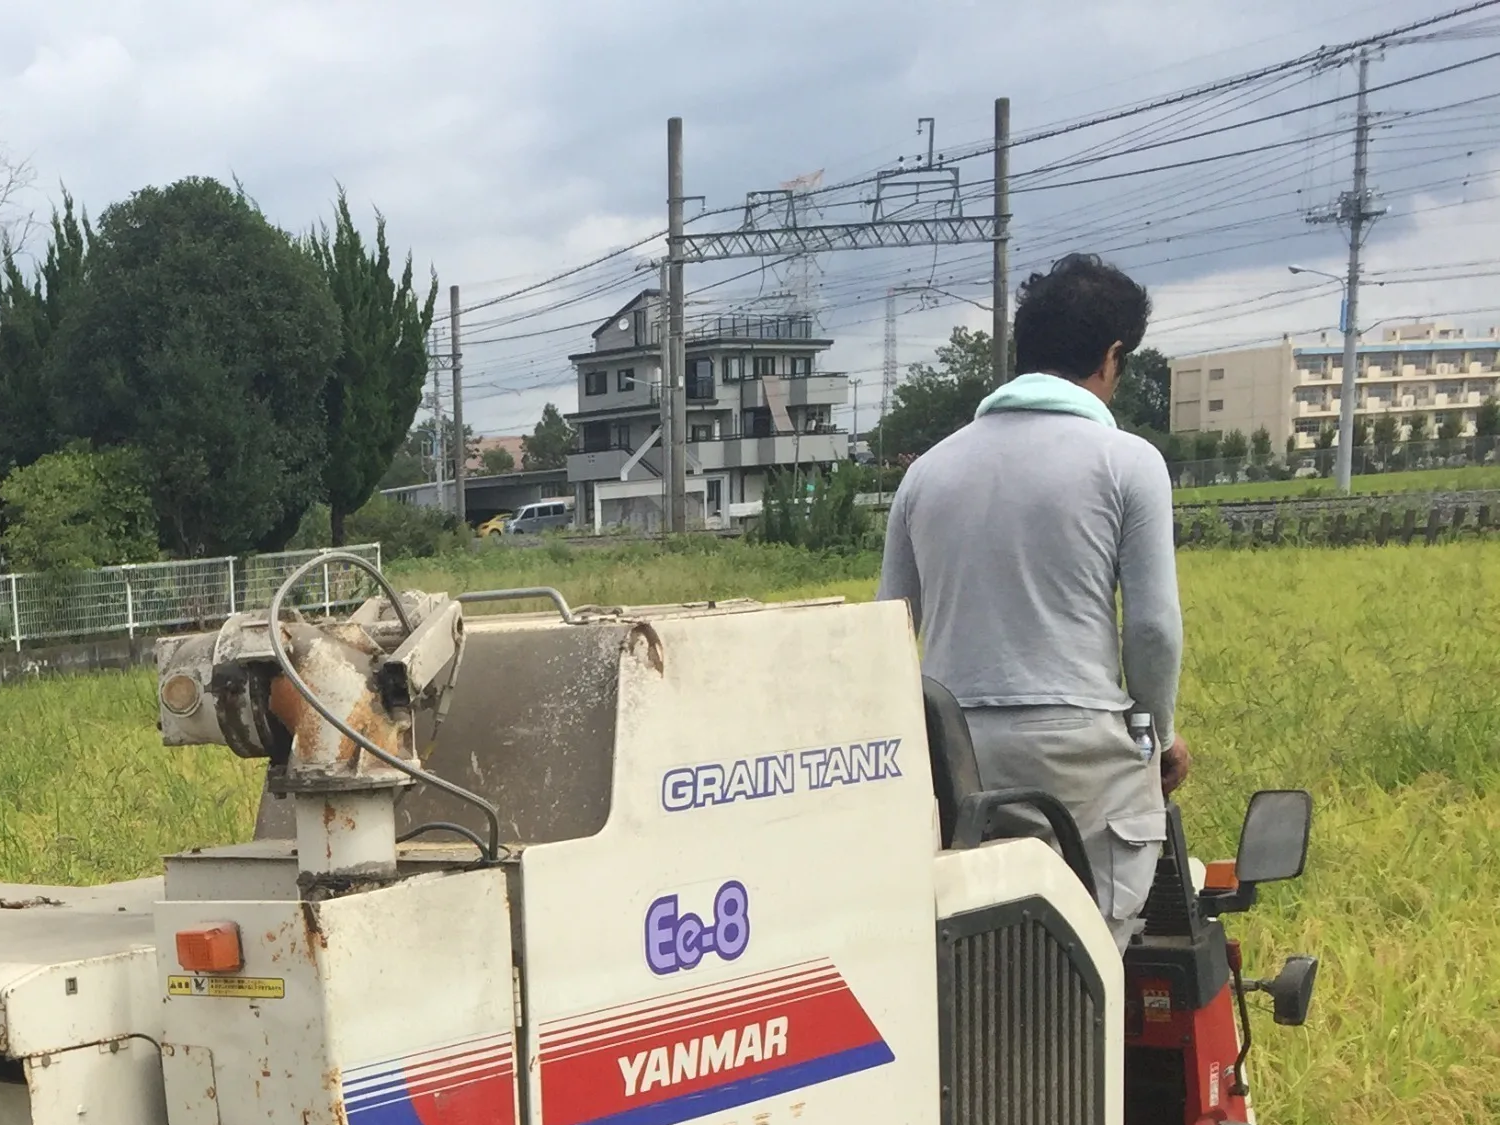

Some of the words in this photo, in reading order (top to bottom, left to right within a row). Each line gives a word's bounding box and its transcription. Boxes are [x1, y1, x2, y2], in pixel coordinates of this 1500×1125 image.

[662, 753, 794, 812] GRAIN
[800, 739, 902, 790] TANK
[644, 880, 750, 975] Ee-8
[618, 1016, 789, 1096] YANMAR
